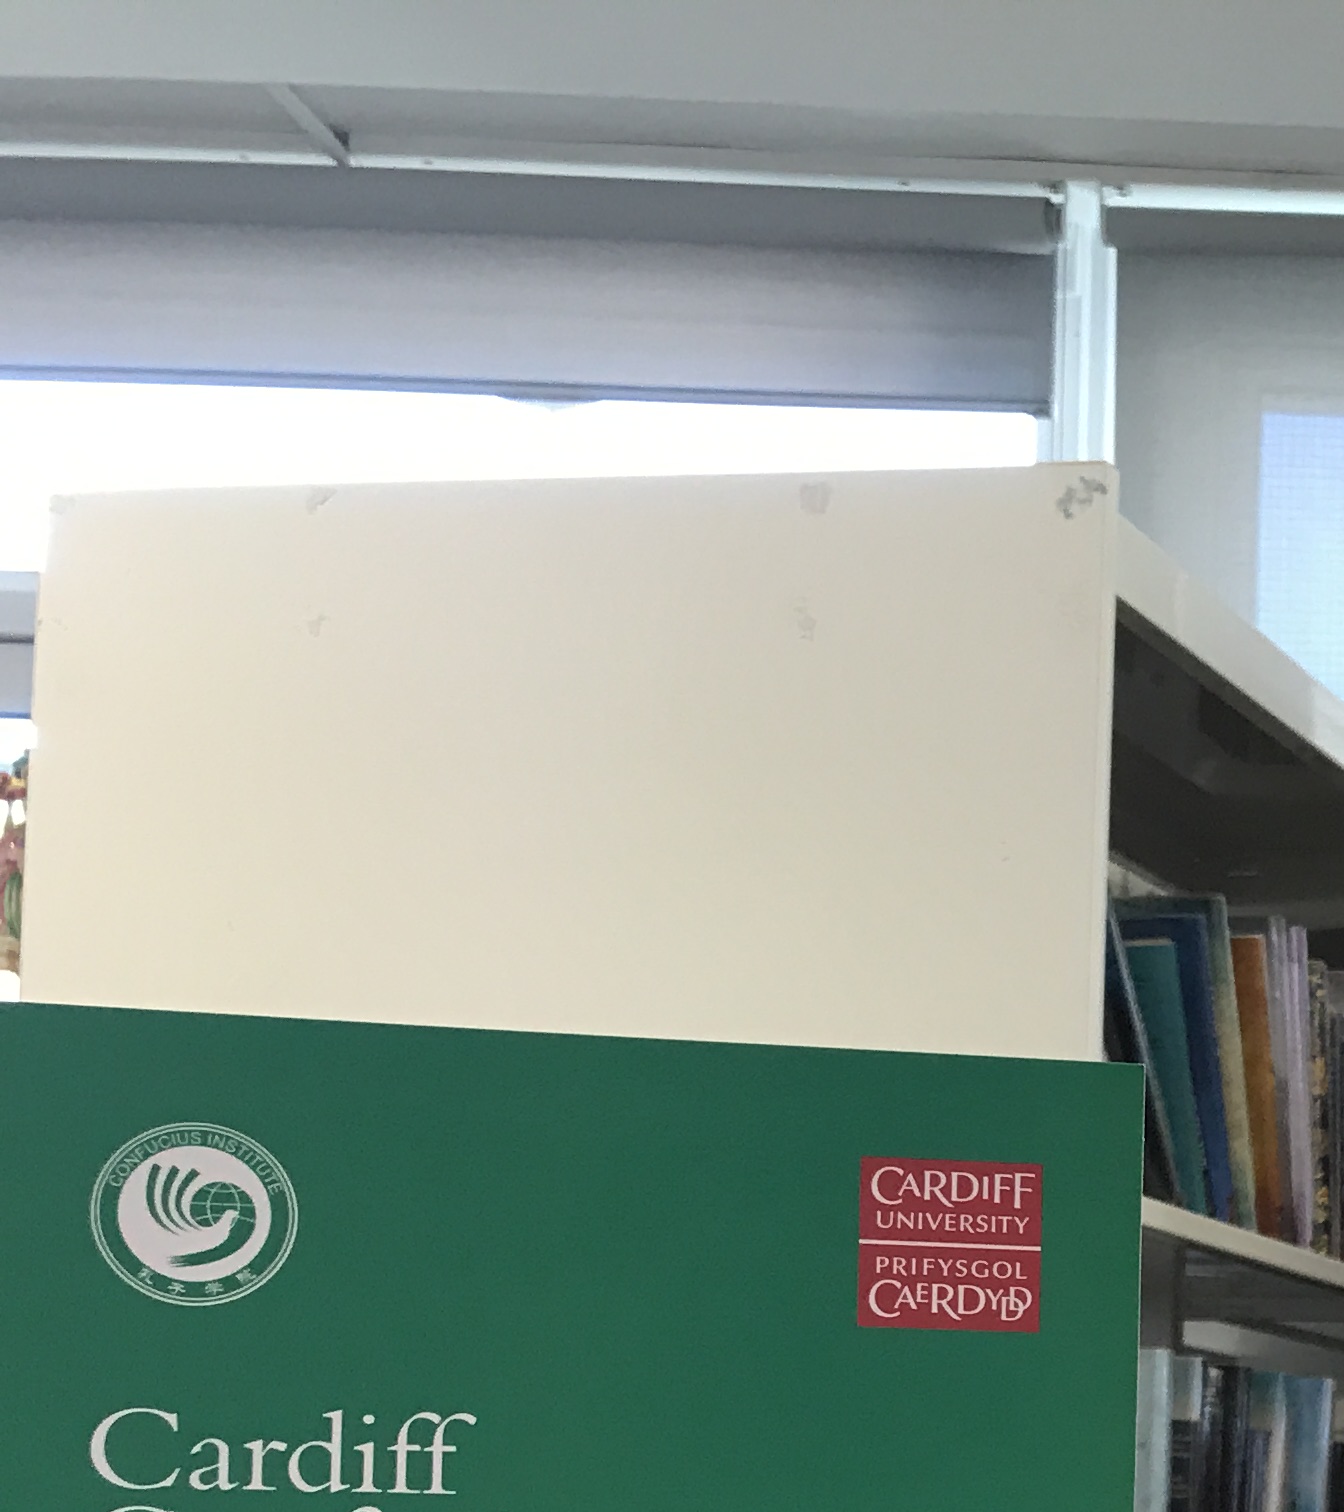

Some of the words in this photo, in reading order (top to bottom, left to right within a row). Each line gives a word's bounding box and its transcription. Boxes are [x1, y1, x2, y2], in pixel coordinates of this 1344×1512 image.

[108, 1131, 202, 1187] CONFUCIUS
[207, 1132, 283, 1196] INSTITUTE
[870, 1166, 1036, 1209] CARDIFF
[876, 1210, 1030, 1234] UNIVERSITY
[875, 1256, 1028, 1280] PRIFYSGOL
[868, 1279, 1033, 1321] CAERDYDD
[89, 1407, 477, 1495] Cardiff
